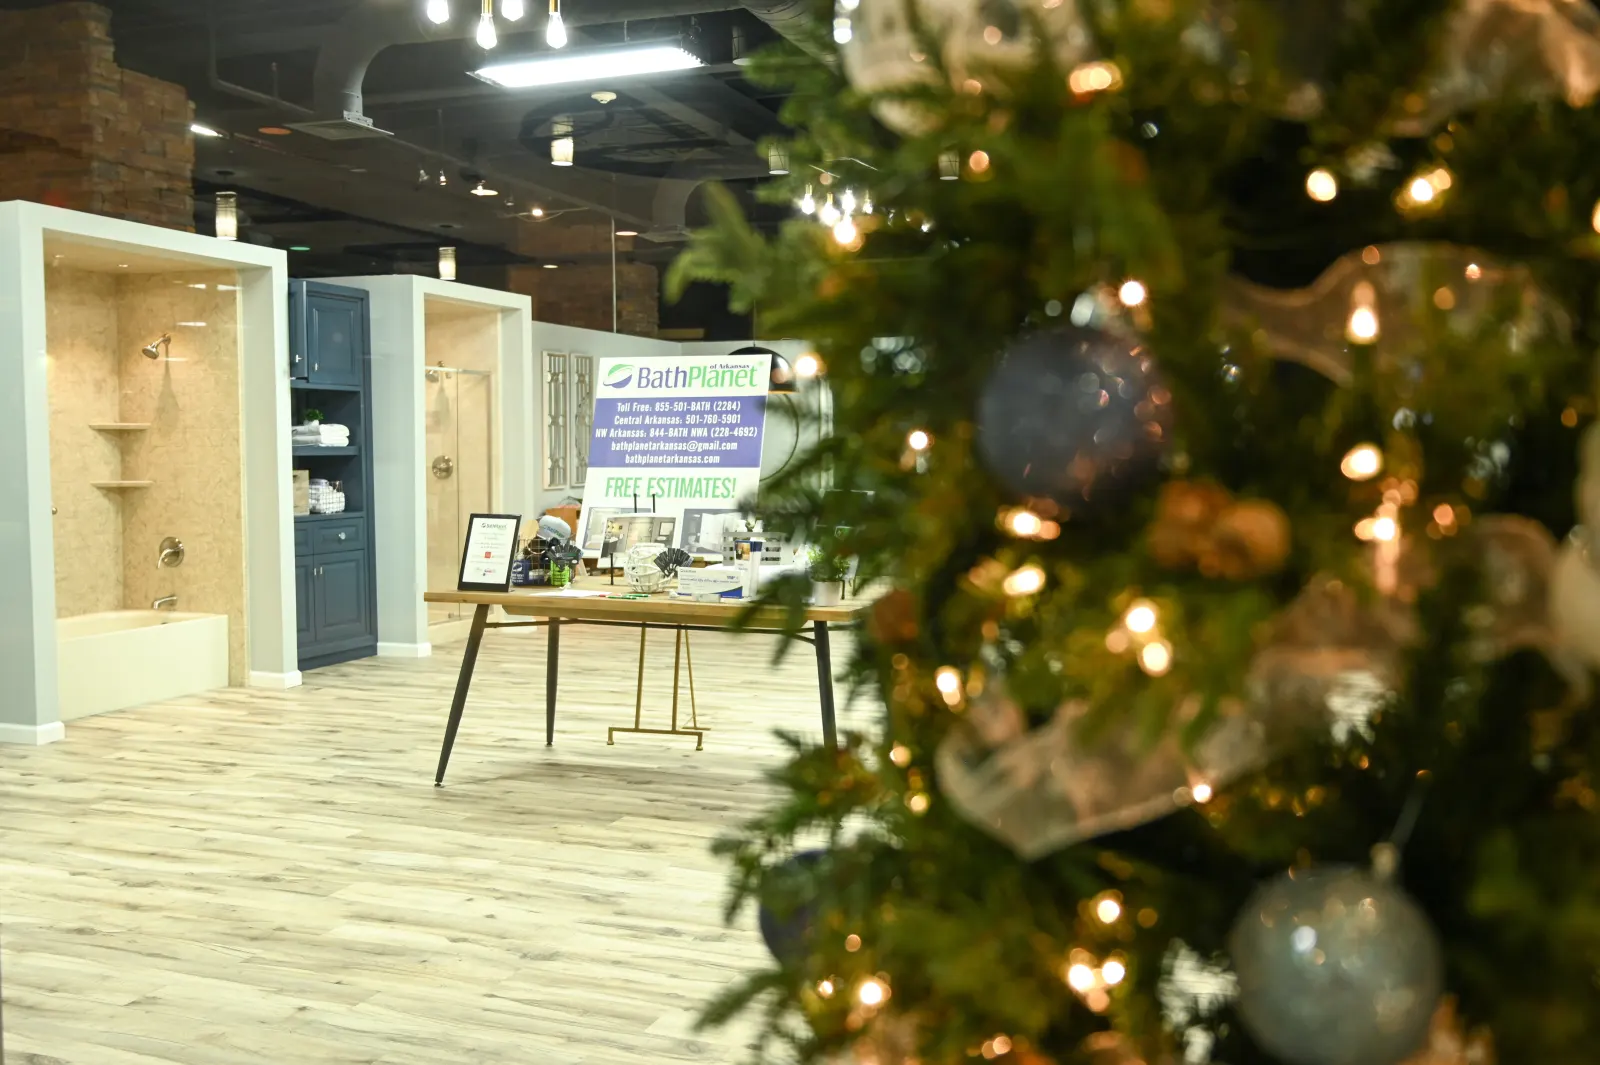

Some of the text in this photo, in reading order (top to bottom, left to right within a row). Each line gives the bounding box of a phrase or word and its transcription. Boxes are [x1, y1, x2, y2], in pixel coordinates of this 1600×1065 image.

[637, 365, 757, 389] BathPlanet
[617, 400, 741, 412] Toll Free: 855-501-BATH (2284)
[614, 413, 741, 425] Central Arkansas: 501-760-5901
[595, 426, 758, 438] NW Arkansas: 844-BATH NWA (228-4692)
[611, 440, 738, 452] bathplanetarkansas@gmail.com
[625, 453, 721, 466] bathplanetarkansas.com
[605, 477, 737, 499] FREE ESTIMATES!
